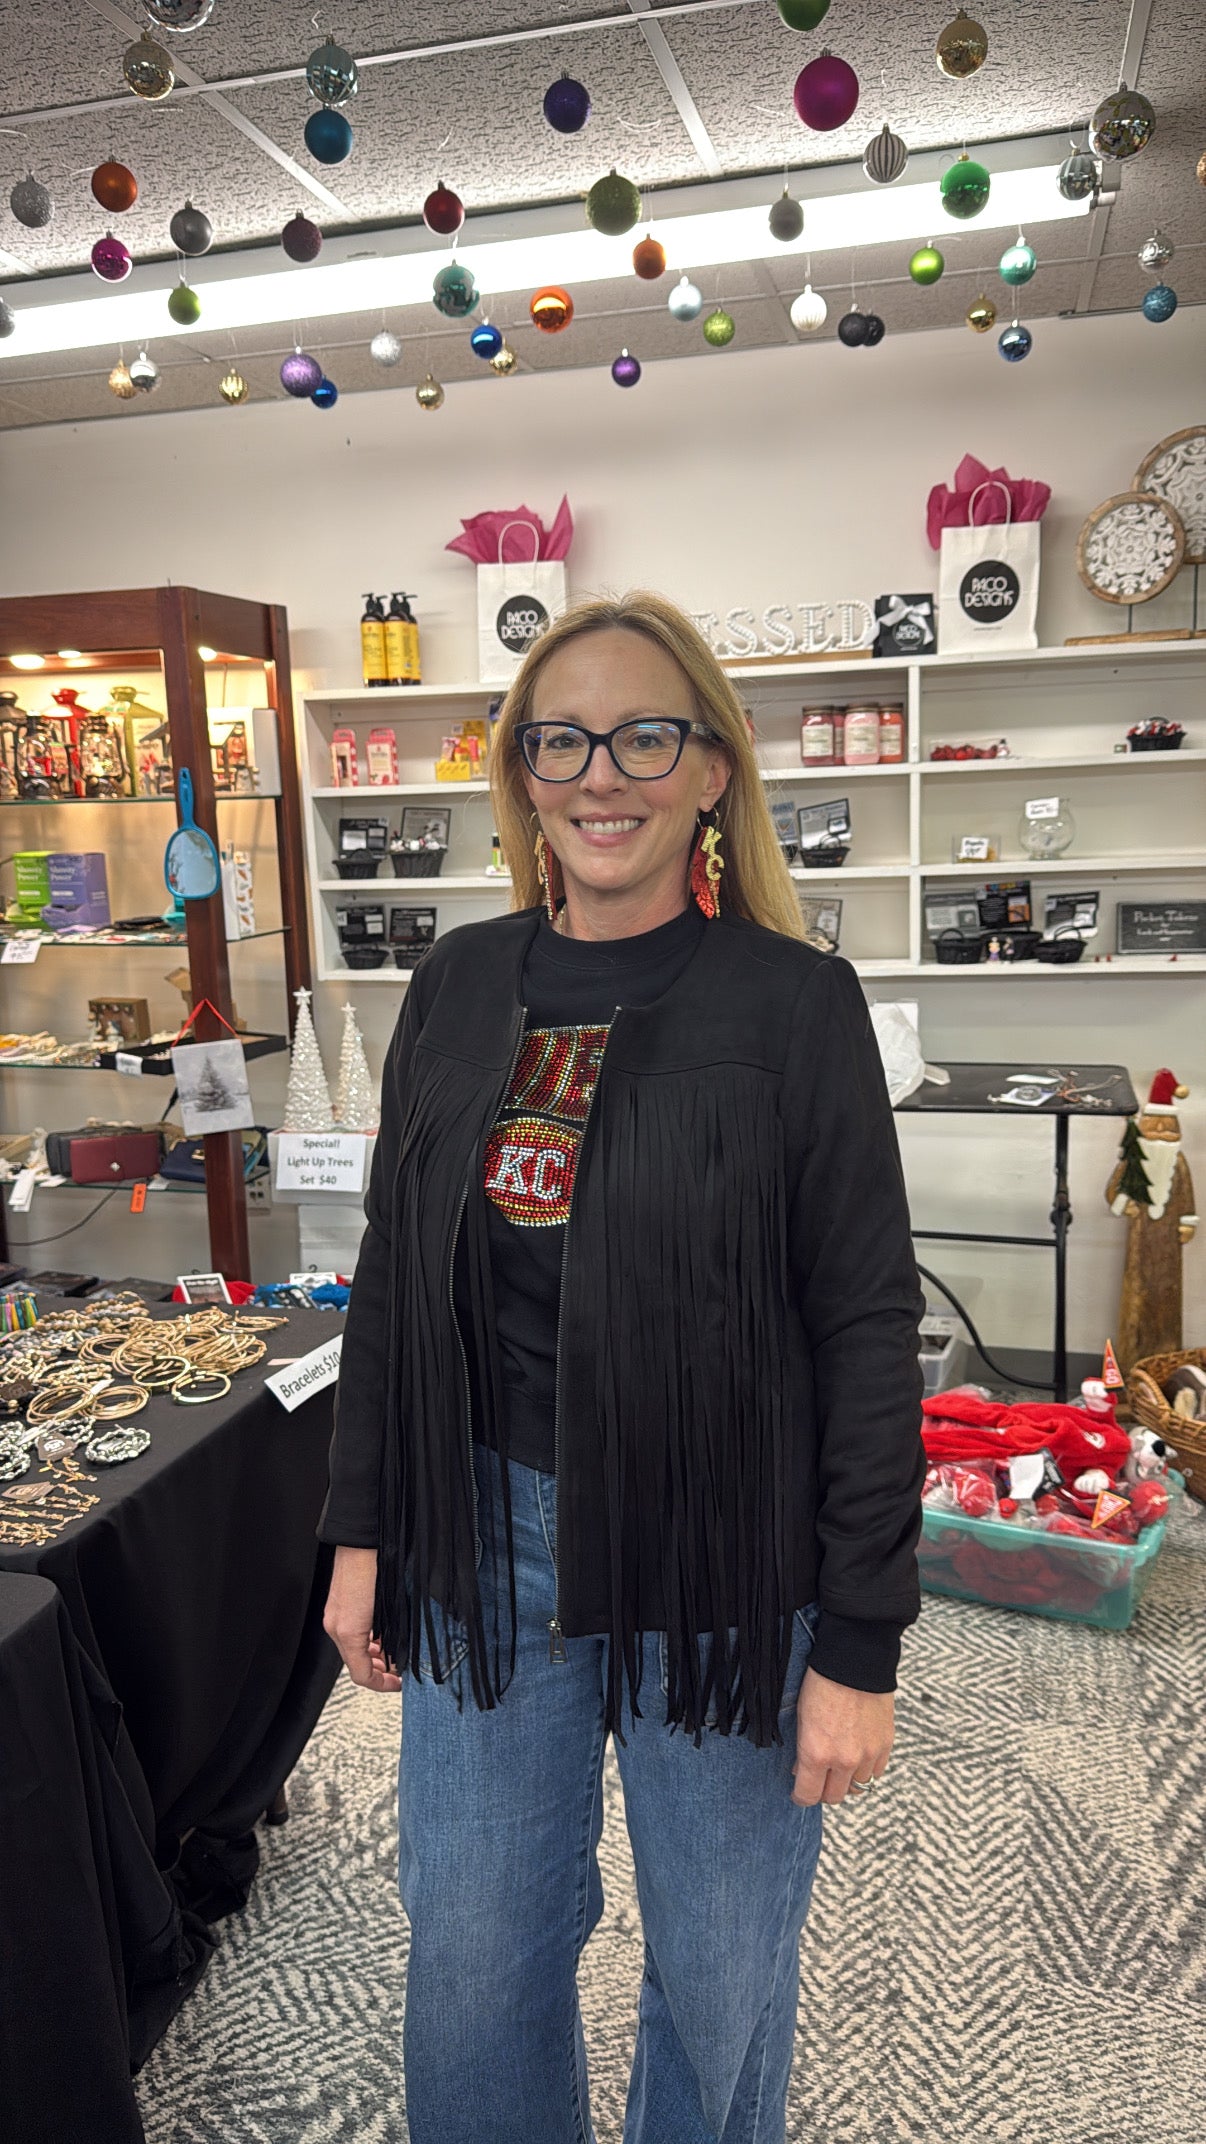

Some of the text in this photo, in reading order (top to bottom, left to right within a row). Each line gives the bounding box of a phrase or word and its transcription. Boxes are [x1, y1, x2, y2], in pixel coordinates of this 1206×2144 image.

[303, 1139, 341, 1150] Special!
[287, 1157, 354, 1168] Light Up Trees
[486, 1144, 567, 1200] KC
[300, 1174, 337, 1185] Set $40
[279, 1351, 341, 1399] Bracelets $10
